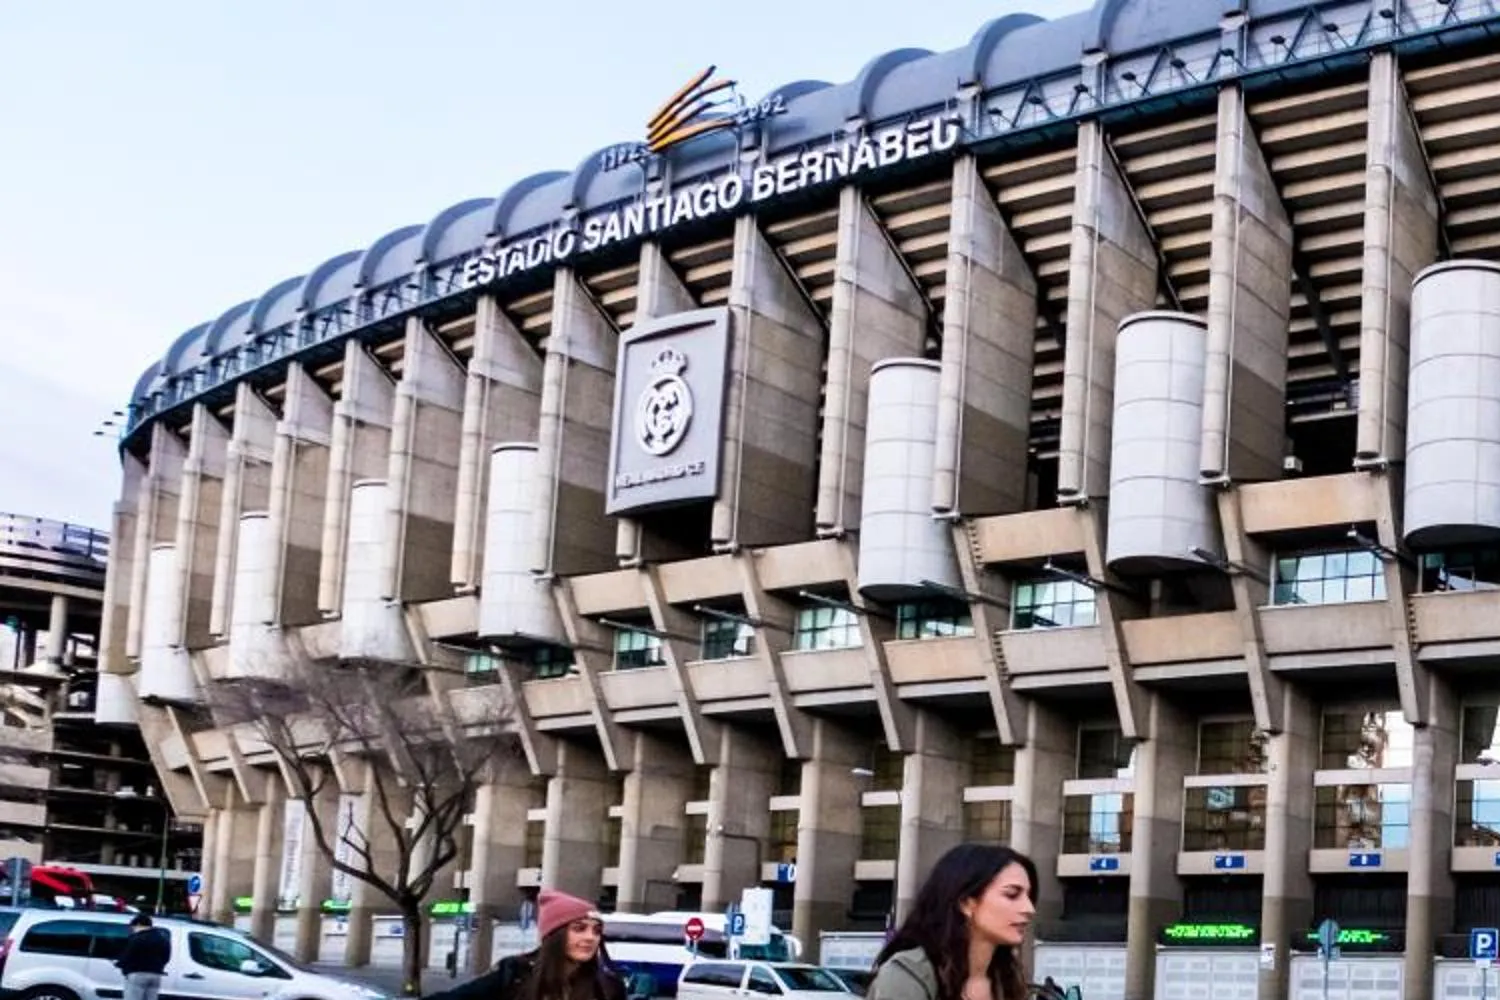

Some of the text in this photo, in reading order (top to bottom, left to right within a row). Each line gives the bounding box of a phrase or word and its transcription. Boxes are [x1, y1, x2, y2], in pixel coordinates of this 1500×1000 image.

[462, 112, 963, 290] ESTADIO SANTIAGO BERNABEU
[1476, 933, 1493, 955] P
